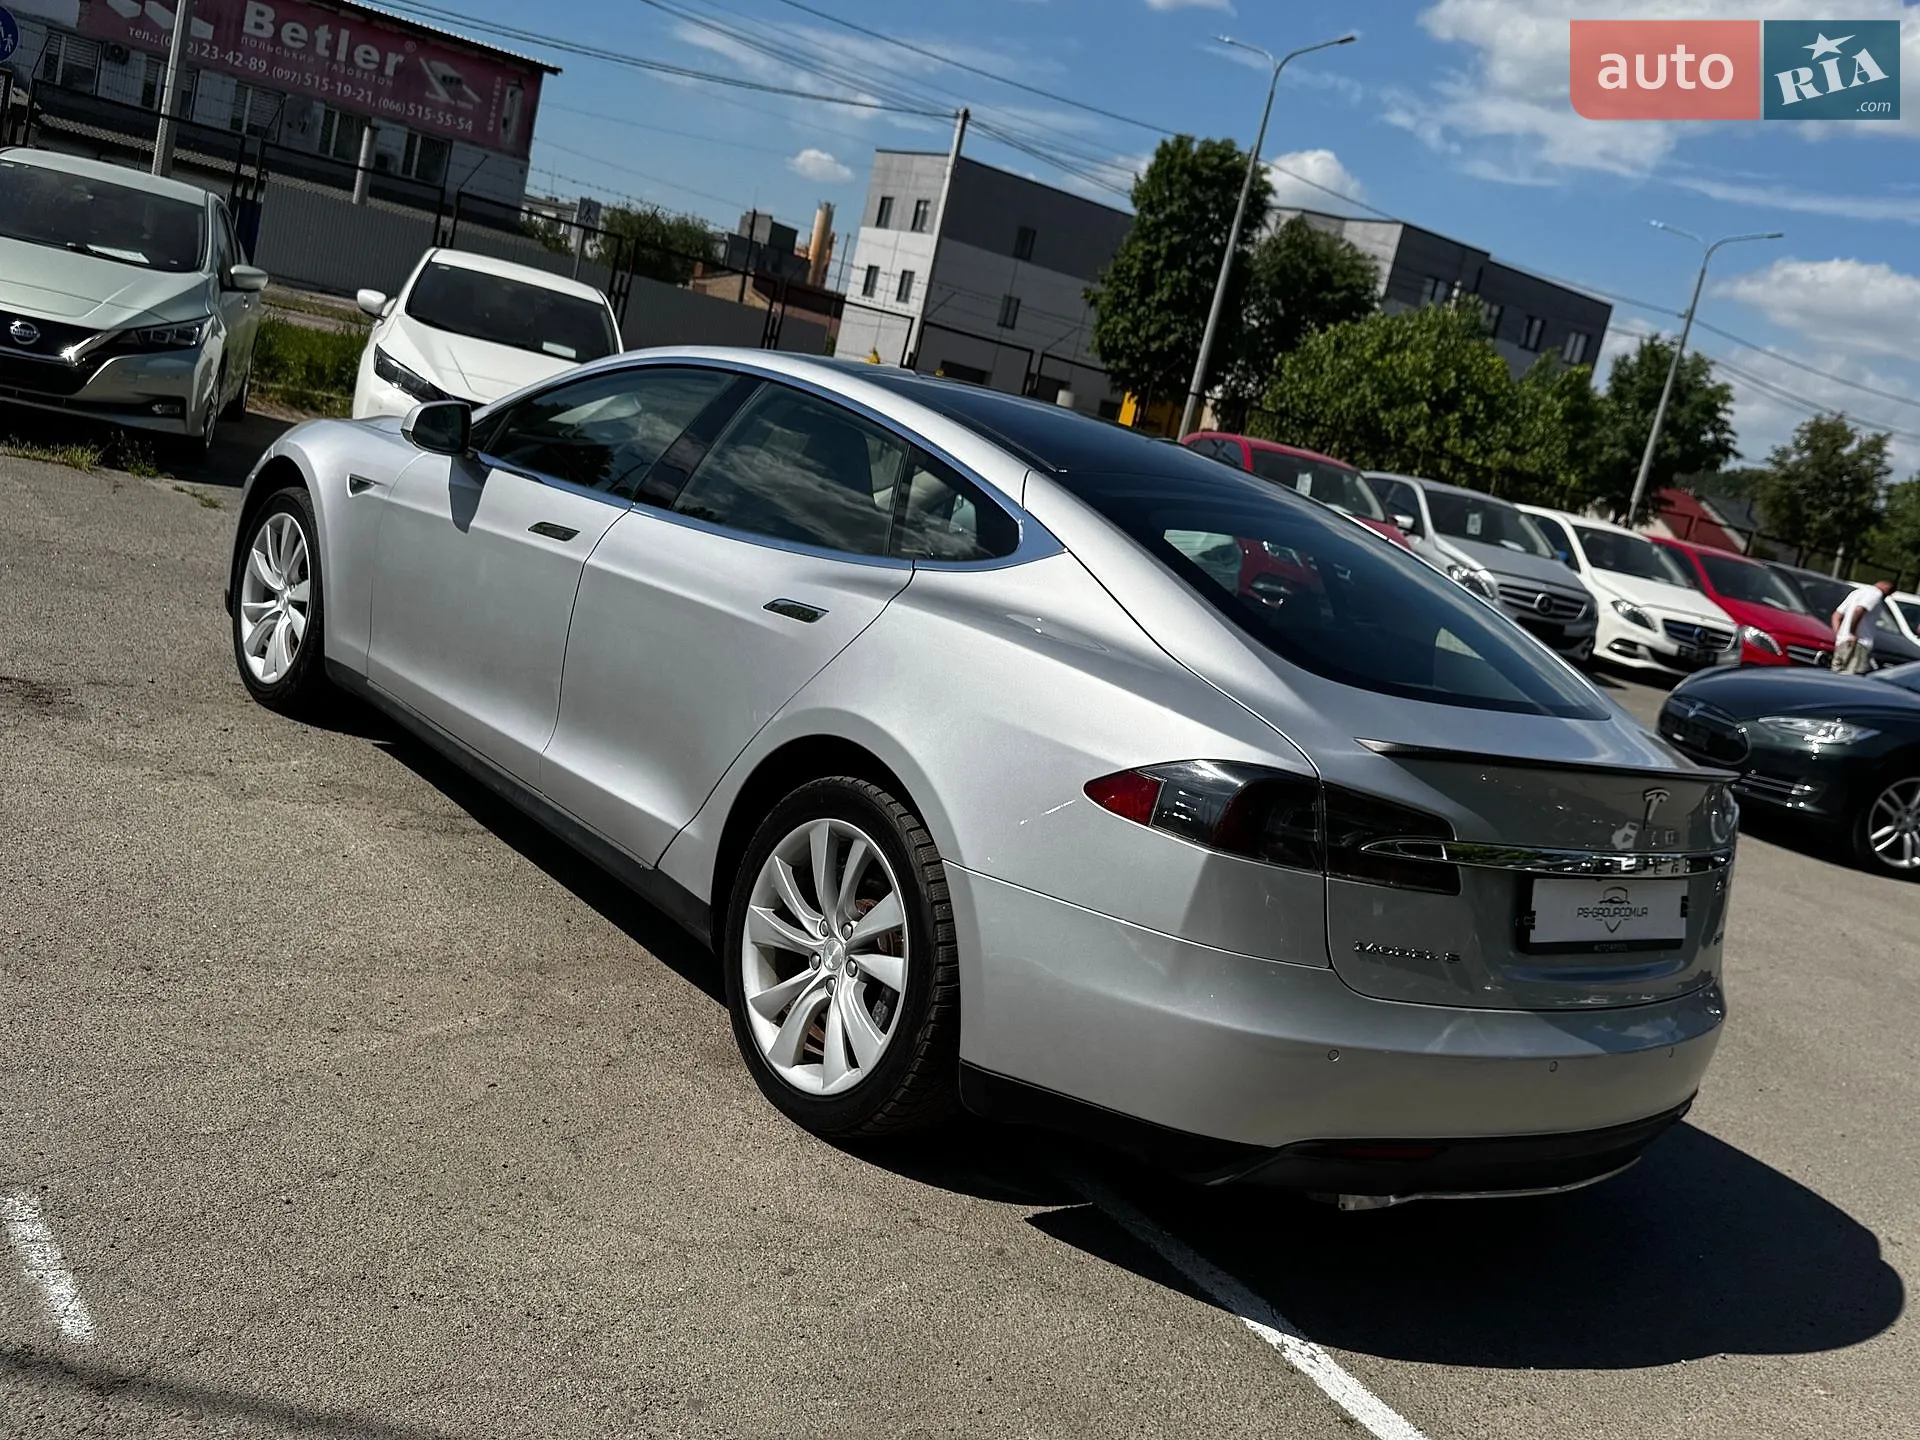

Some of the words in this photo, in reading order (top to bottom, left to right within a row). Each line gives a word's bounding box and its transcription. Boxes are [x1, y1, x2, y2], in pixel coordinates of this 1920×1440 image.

[243, 1, 404, 77] Betler
[272, 66, 300, 86] (097)
[408, 104, 473, 133] 515-55-54
